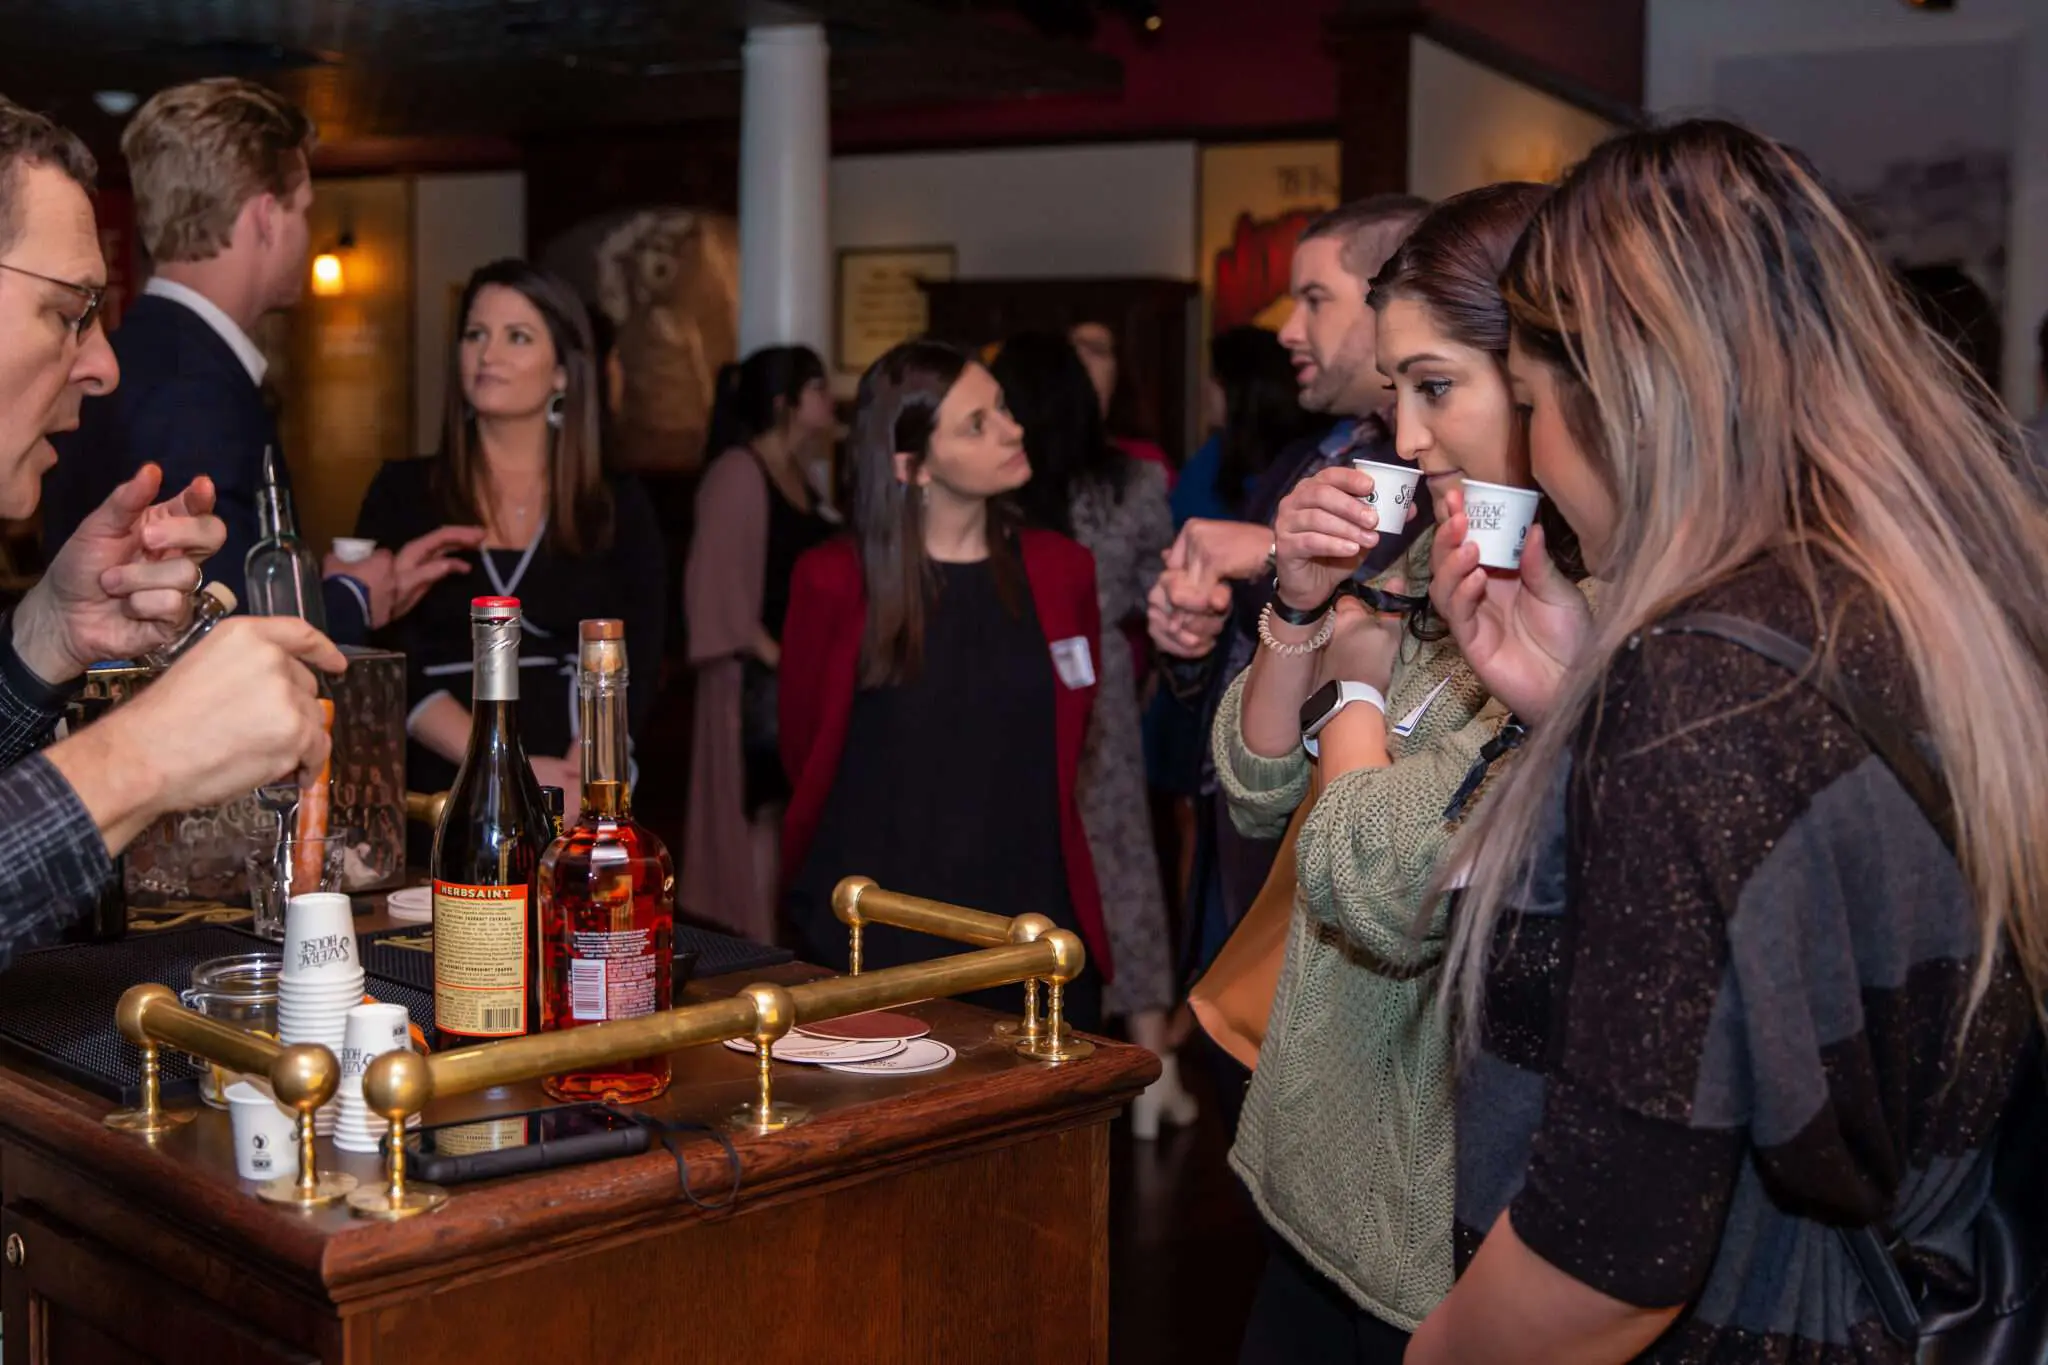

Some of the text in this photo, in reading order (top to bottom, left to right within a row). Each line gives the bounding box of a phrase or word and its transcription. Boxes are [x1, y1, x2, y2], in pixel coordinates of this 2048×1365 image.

[1464, 504, 1506, 519] AZERAC
[1467, 518, 1502, 531] OUSE
[441, 885, 512, 899] HERBSAINT
[297, 936, 350, 968] SAZERAC
[300, 935, 337, 954] HOUSE
